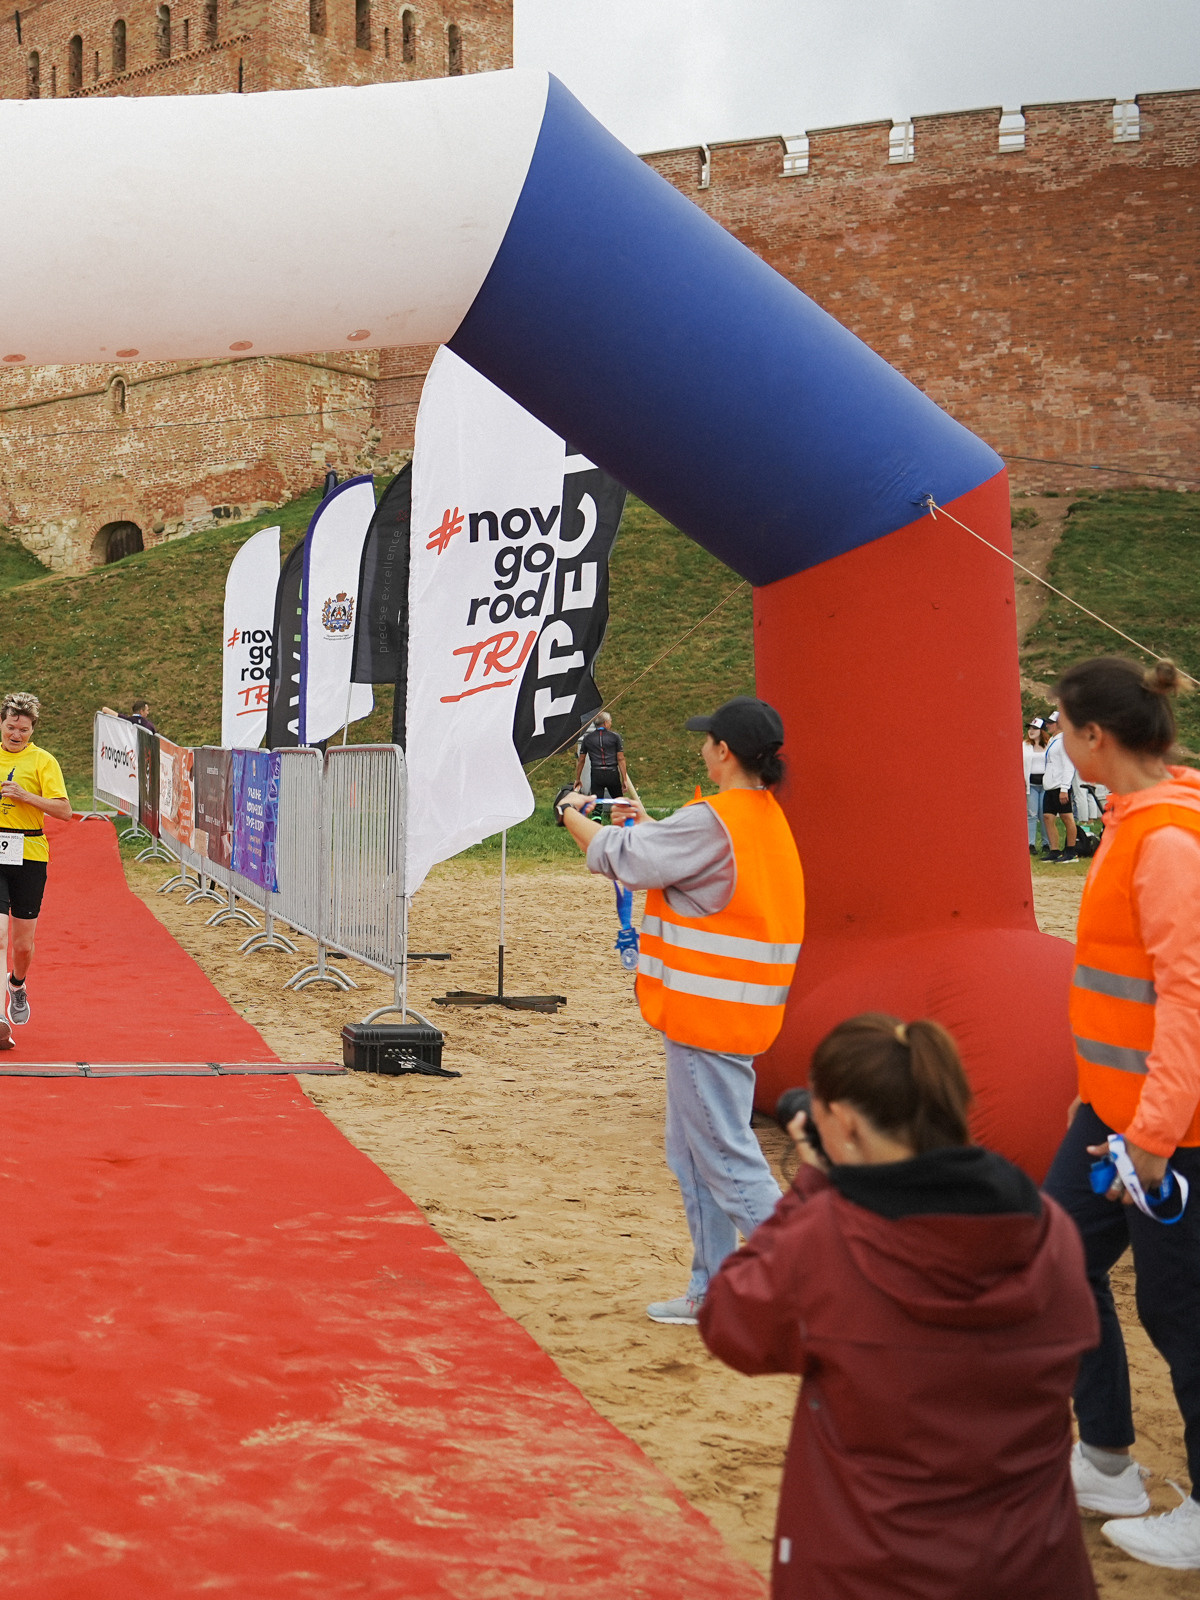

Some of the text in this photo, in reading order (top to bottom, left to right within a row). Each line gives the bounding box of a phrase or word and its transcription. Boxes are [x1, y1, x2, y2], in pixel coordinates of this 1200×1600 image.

[426, 505, 561, 555] #nov
[494, 542, 555, 590] go
[378, 530, 402, 653] precise excellence
[467, 572, 550, 626] rod
[453, 630, 537, 681] TRI
[238, 685, 269, 706] TR
